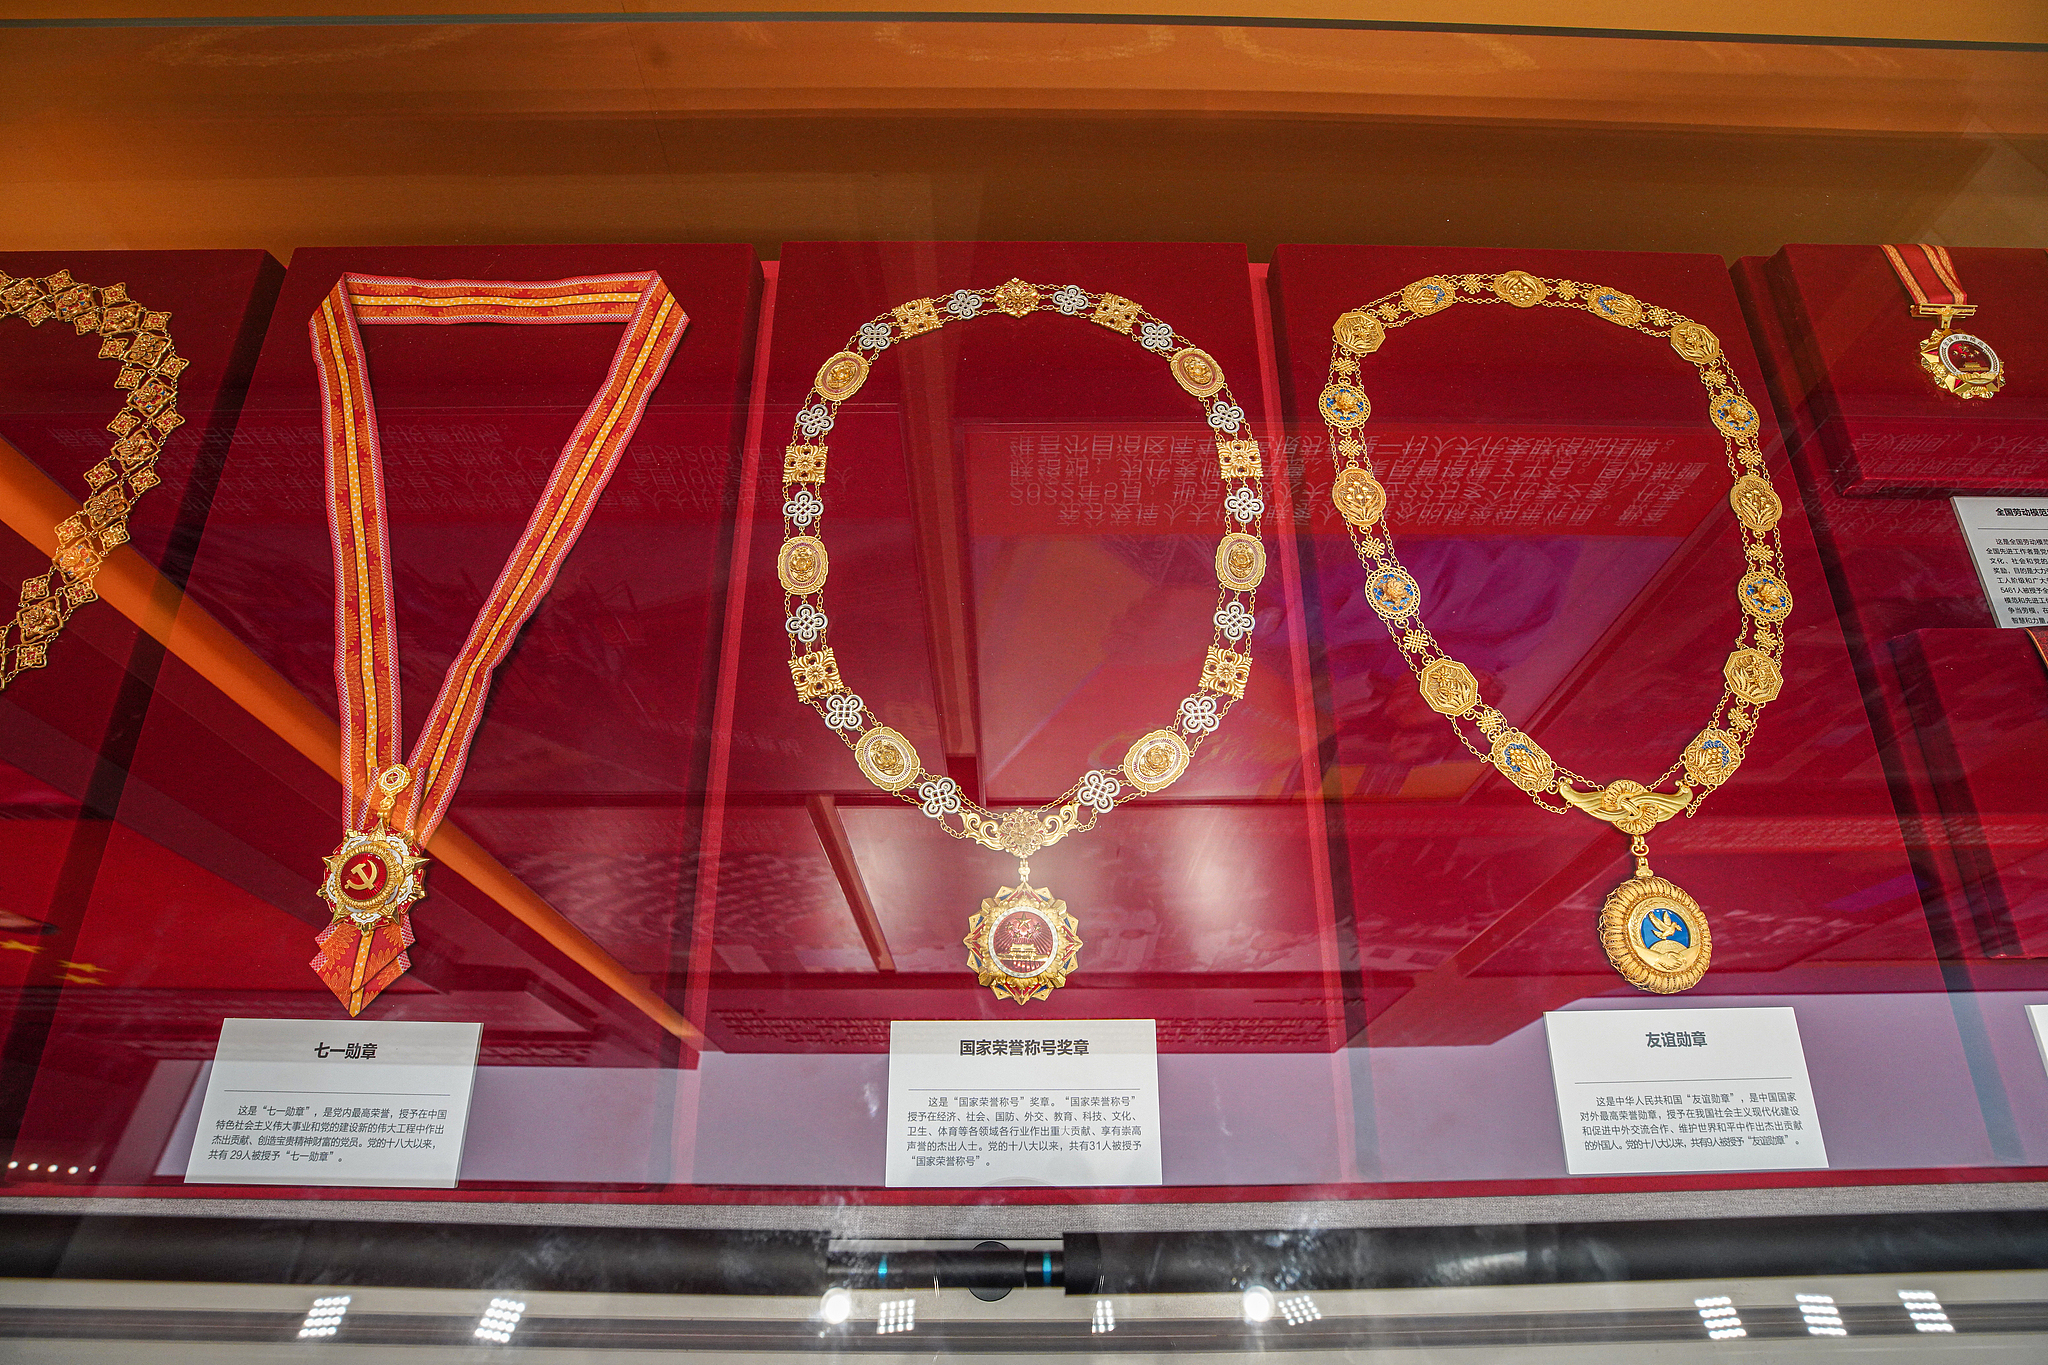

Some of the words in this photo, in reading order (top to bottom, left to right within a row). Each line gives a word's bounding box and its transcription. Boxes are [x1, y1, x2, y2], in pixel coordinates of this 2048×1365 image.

[1995, 507, 2048, 517] 全国劳动模范
[1986, 547, 2048, 555] 全国先进工作者是党
[1645, 1031, 1707, 1048] 友谊勋章
[314, 1042, 377, 1060] 七一勋章
[959, 1039, 1089, 1056] 国家荣誉称号奖章
[907, 1111, 1136, 1122] 授予在经济、社会、国防、外交、教育、科技、文化、
[1579, 1105, 1800, 1122] 对外最高荣誉勋章，授予在我国社会主义现代化建设
[215, 1119, 445, 1135] 特色社会主义伟大事业和党的建设新的伟大工程中作出
[907, 1125, 1141, 1137] 卫生、体育等各领域各行业作出重大贡献、享有崇高
[1582, 1120, 1803, 1136] 和促进中外交流合作、维护世界和平中作出杰出贡献
[211, 1134, 436, 1149] 杰出贡献、创造宝贵精神财富的党员。党的十八大以来，
[906, 1140, 1141, 1152] 声誉的杰出人士。党的十八大以来，共有31人被授予
